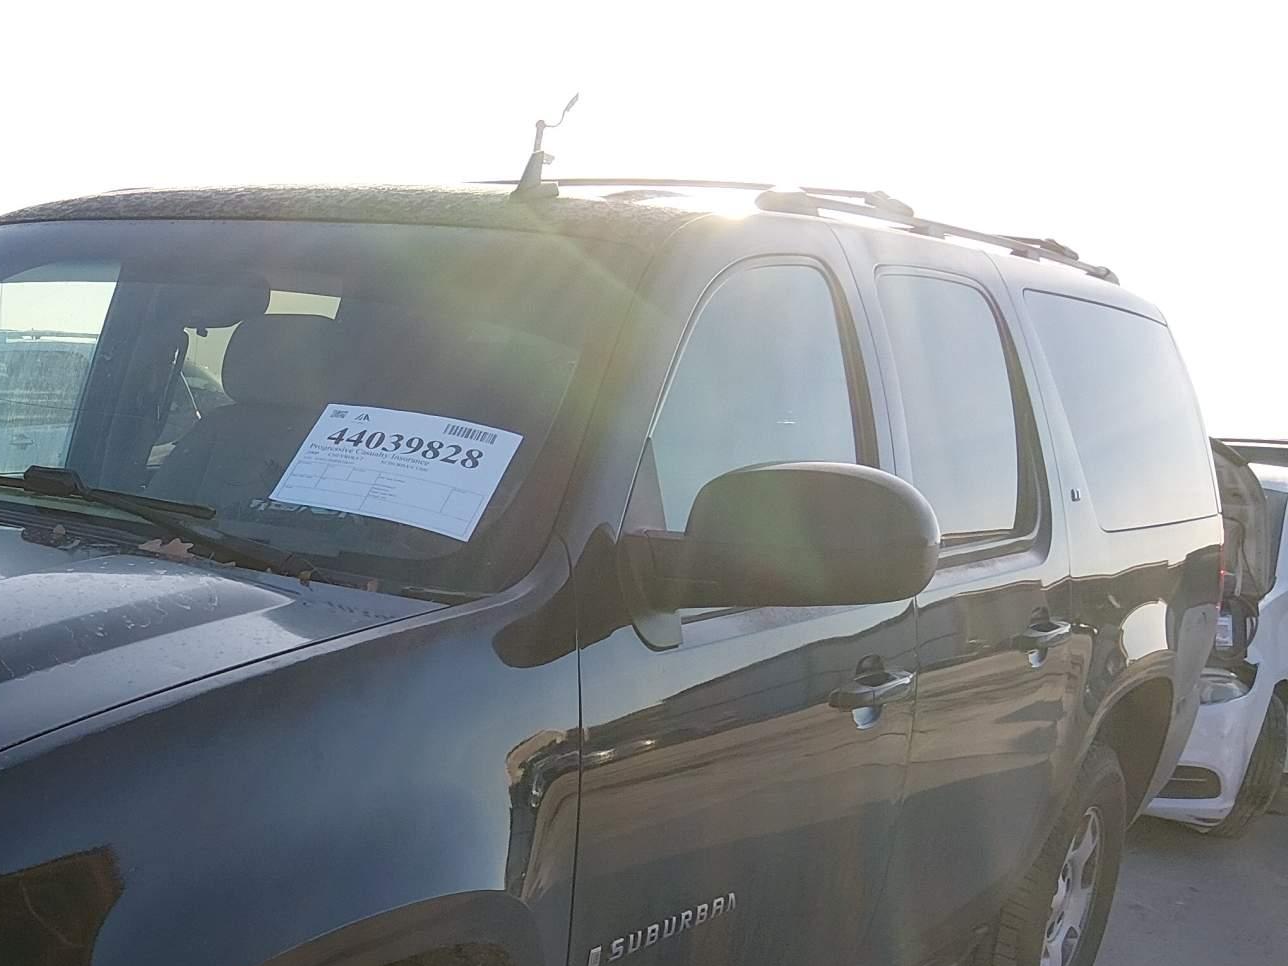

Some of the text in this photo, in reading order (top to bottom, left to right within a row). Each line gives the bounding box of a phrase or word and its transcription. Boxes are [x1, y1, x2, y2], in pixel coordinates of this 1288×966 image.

[310, 443, 353, 455] Progressive
[355, 448, 388, 460] Casualty
[391, 453, 430, 466] Insurance
[327, 427, 484, 469] 44039828
[608, 892, 737, 962] SUBURBAN
